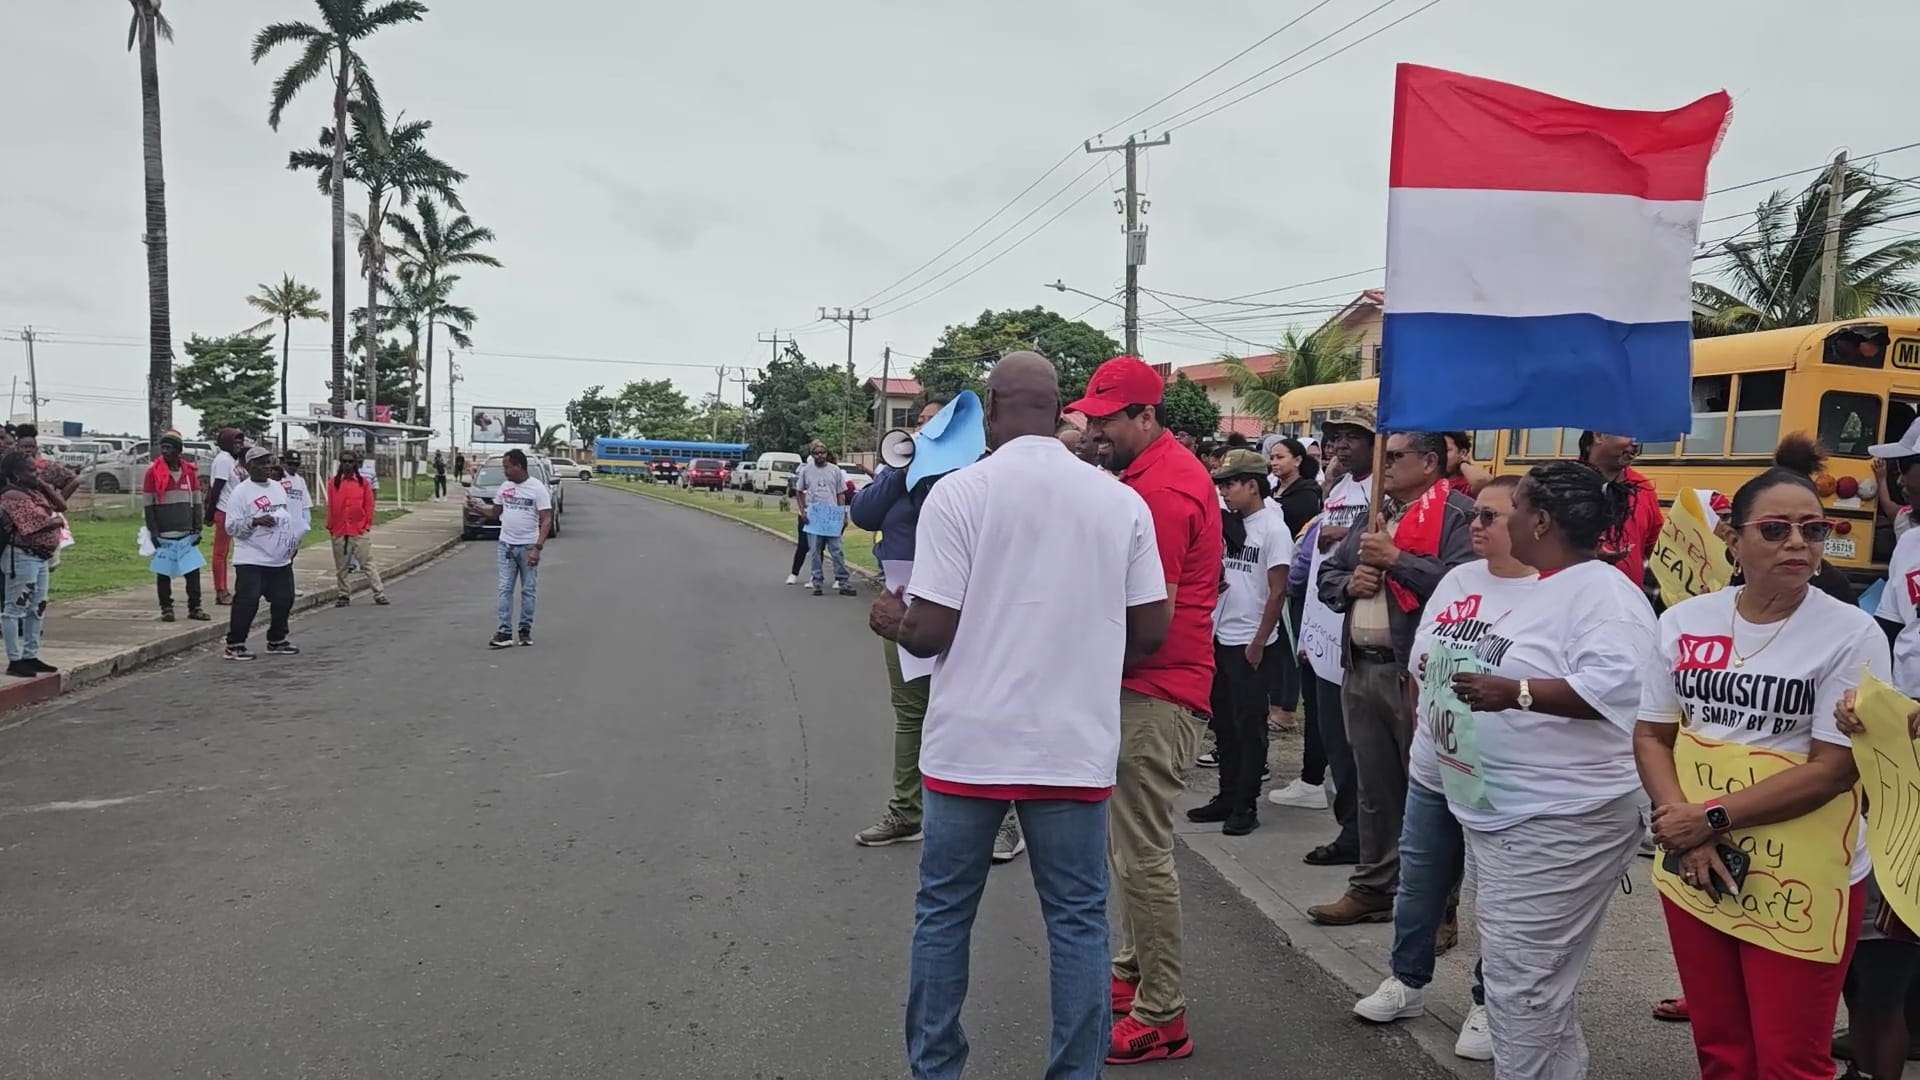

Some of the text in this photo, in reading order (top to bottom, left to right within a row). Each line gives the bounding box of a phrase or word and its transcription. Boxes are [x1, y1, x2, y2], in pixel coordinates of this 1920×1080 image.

[1673, 667, 1816, 716] ACQUISITION
[1702, 706, 1743, 728] SMART
[1747, 714, 1767, 731] BY
[1772, 717, 1798, 735] BTL
[1736, 836, 1784, 868] ay
[1128, 1030, 1160, 1051] PUMA
